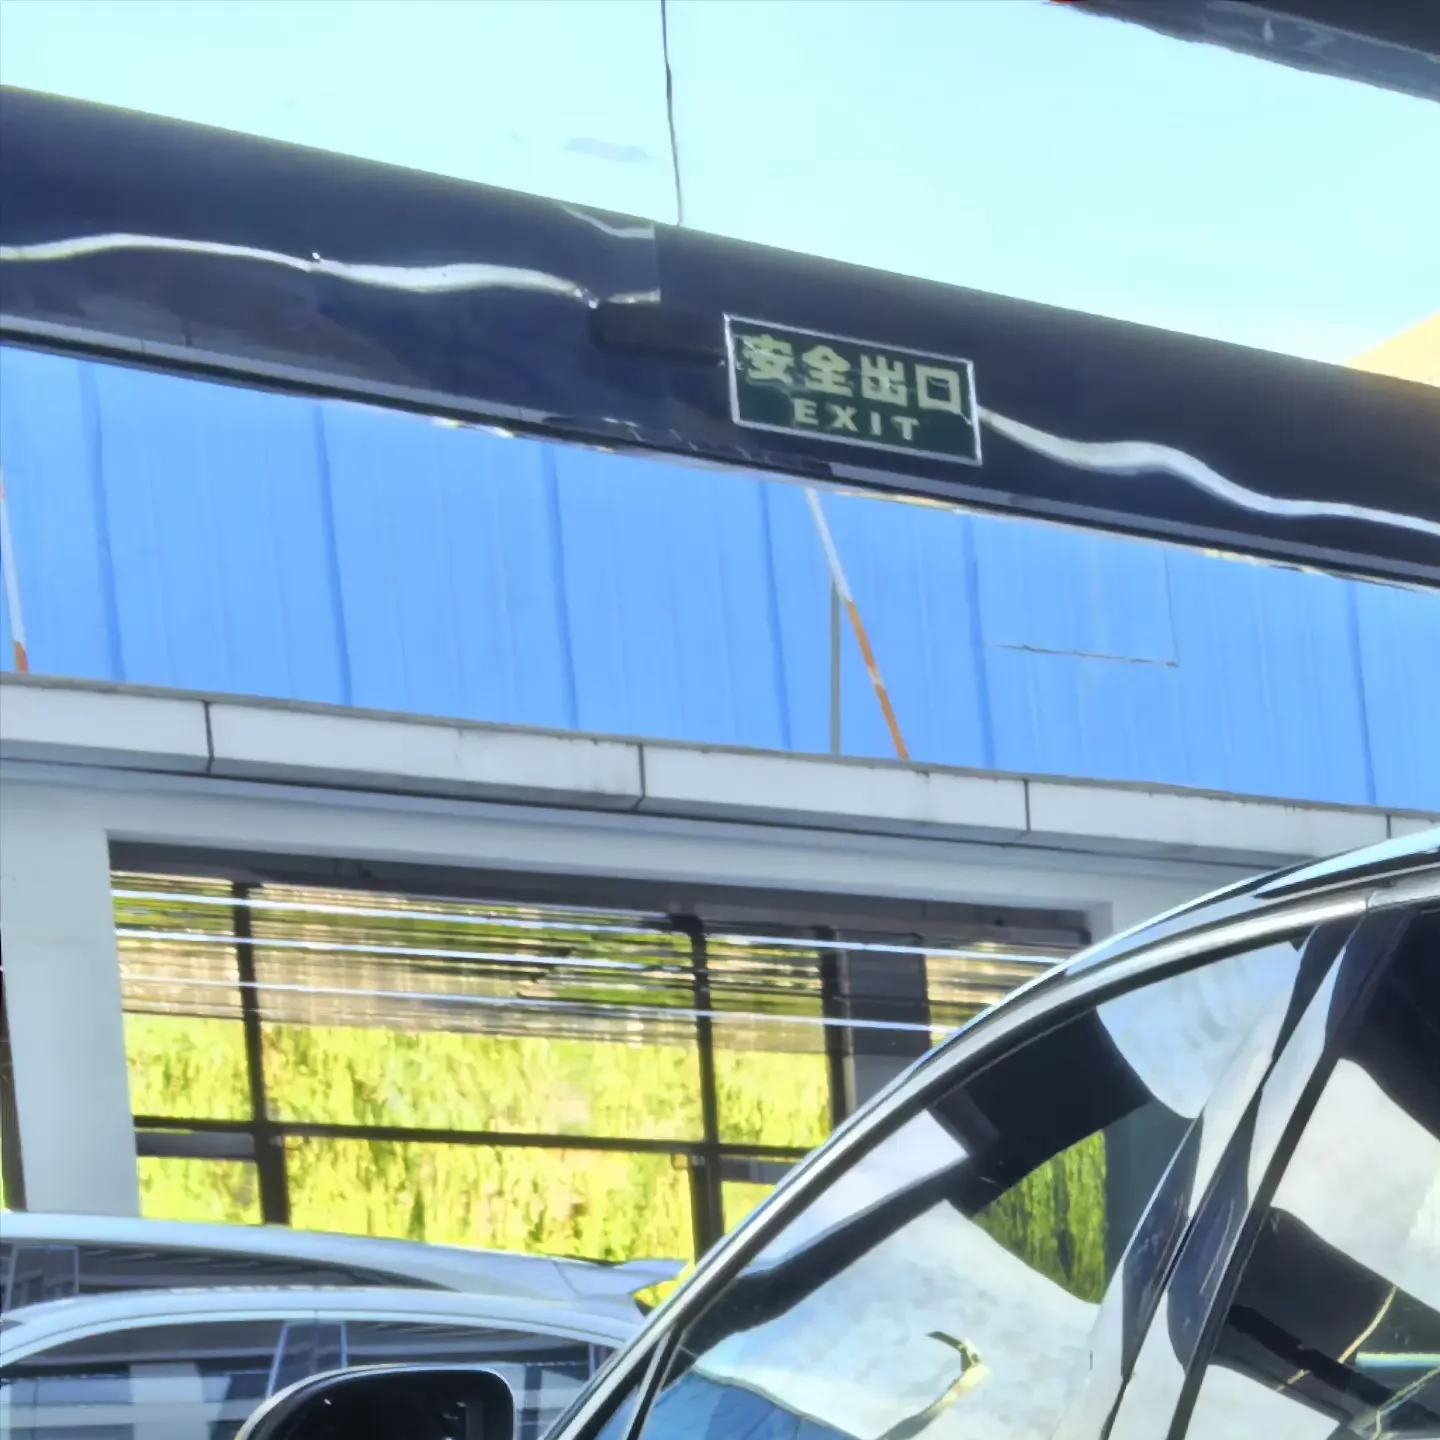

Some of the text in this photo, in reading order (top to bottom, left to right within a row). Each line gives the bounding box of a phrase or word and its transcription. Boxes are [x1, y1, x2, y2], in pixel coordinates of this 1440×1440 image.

[742, 334, 962, 415] 安全出口
[793, 398, 920, 441] EXIT
